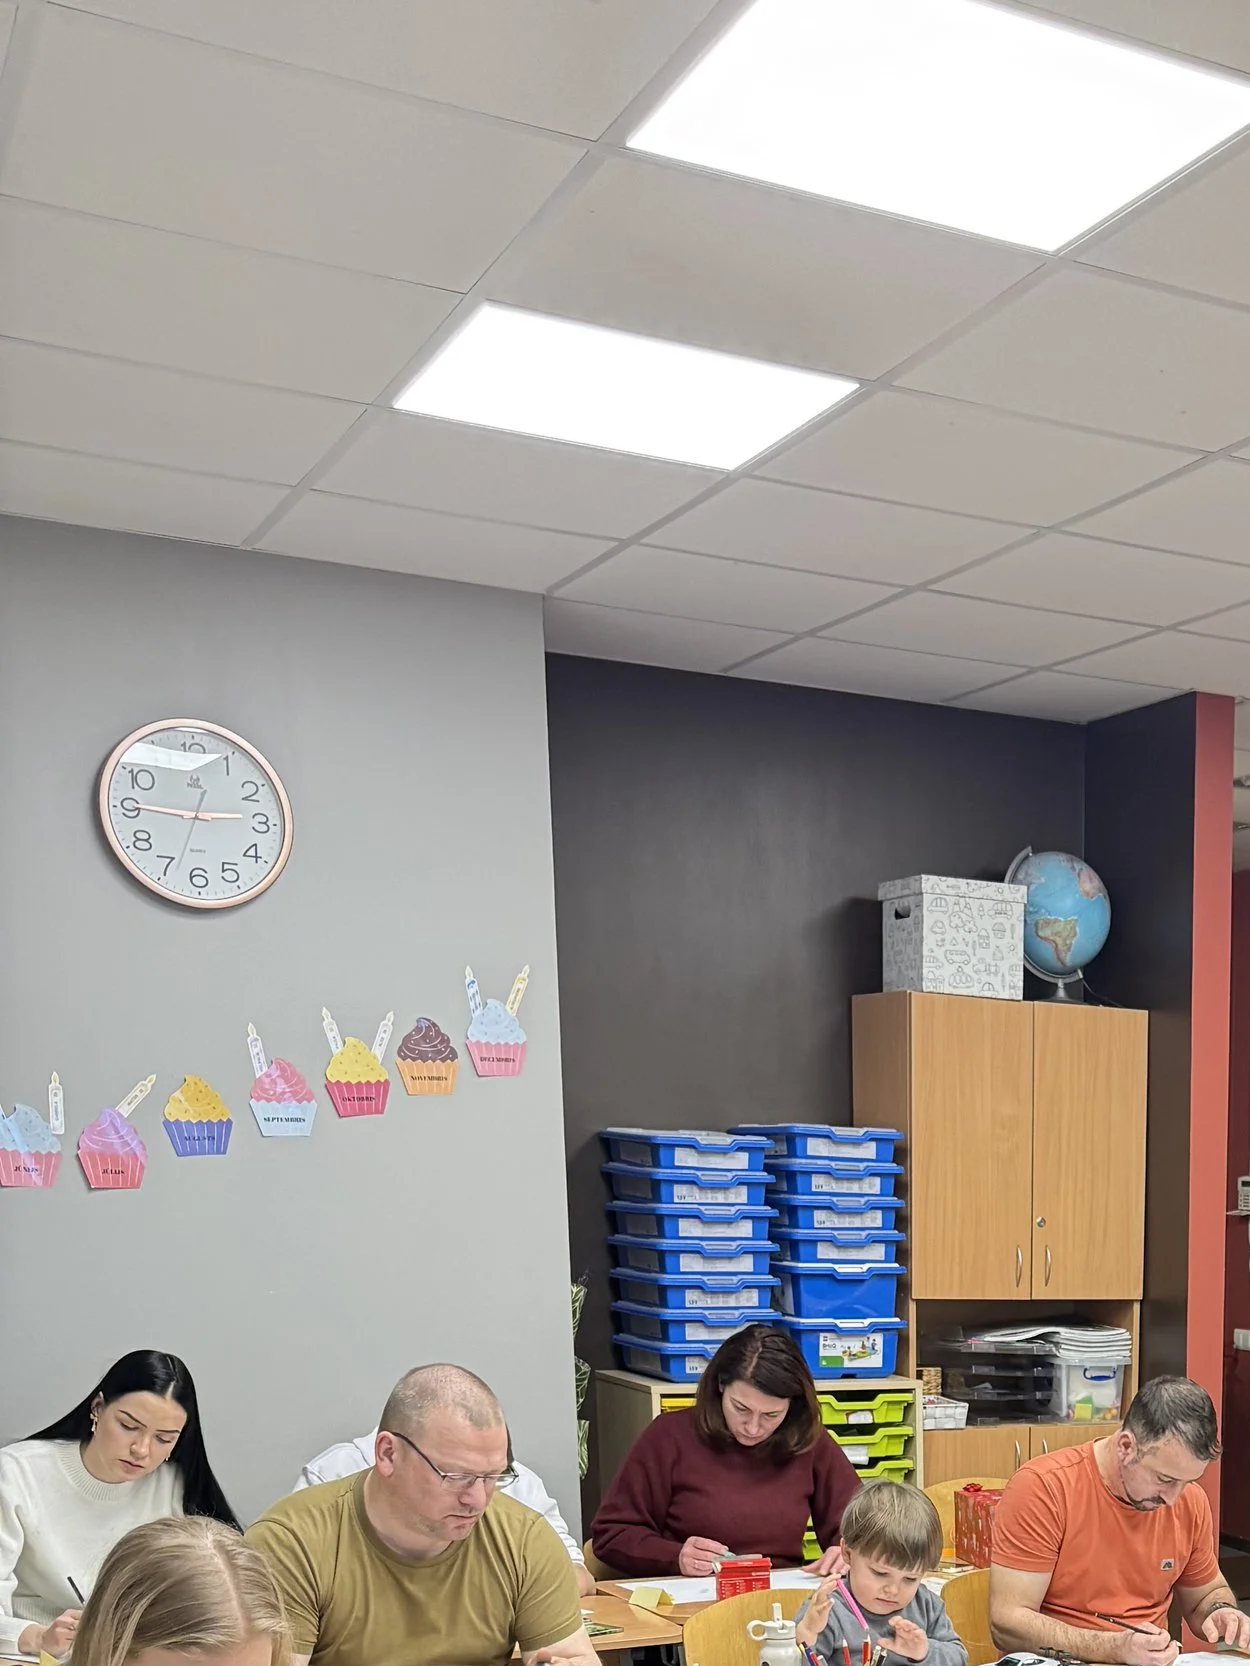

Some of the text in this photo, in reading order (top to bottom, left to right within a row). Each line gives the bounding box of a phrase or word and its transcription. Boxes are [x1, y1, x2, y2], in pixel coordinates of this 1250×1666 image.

[223, 755, 230, 776] 1
[128, 768, 155, 791] 10
[241, 781, 260, 803] 2
[120, 797, 140, 819] 9
[252, 812, 270, 834] 3
[133, 829, 152, 851] 8
[242, 843, 262, 864] 4
[156, 855, 176, 876] 7
[221, 861, 240, 883] 5
[189, 867, 209, 889] 6
